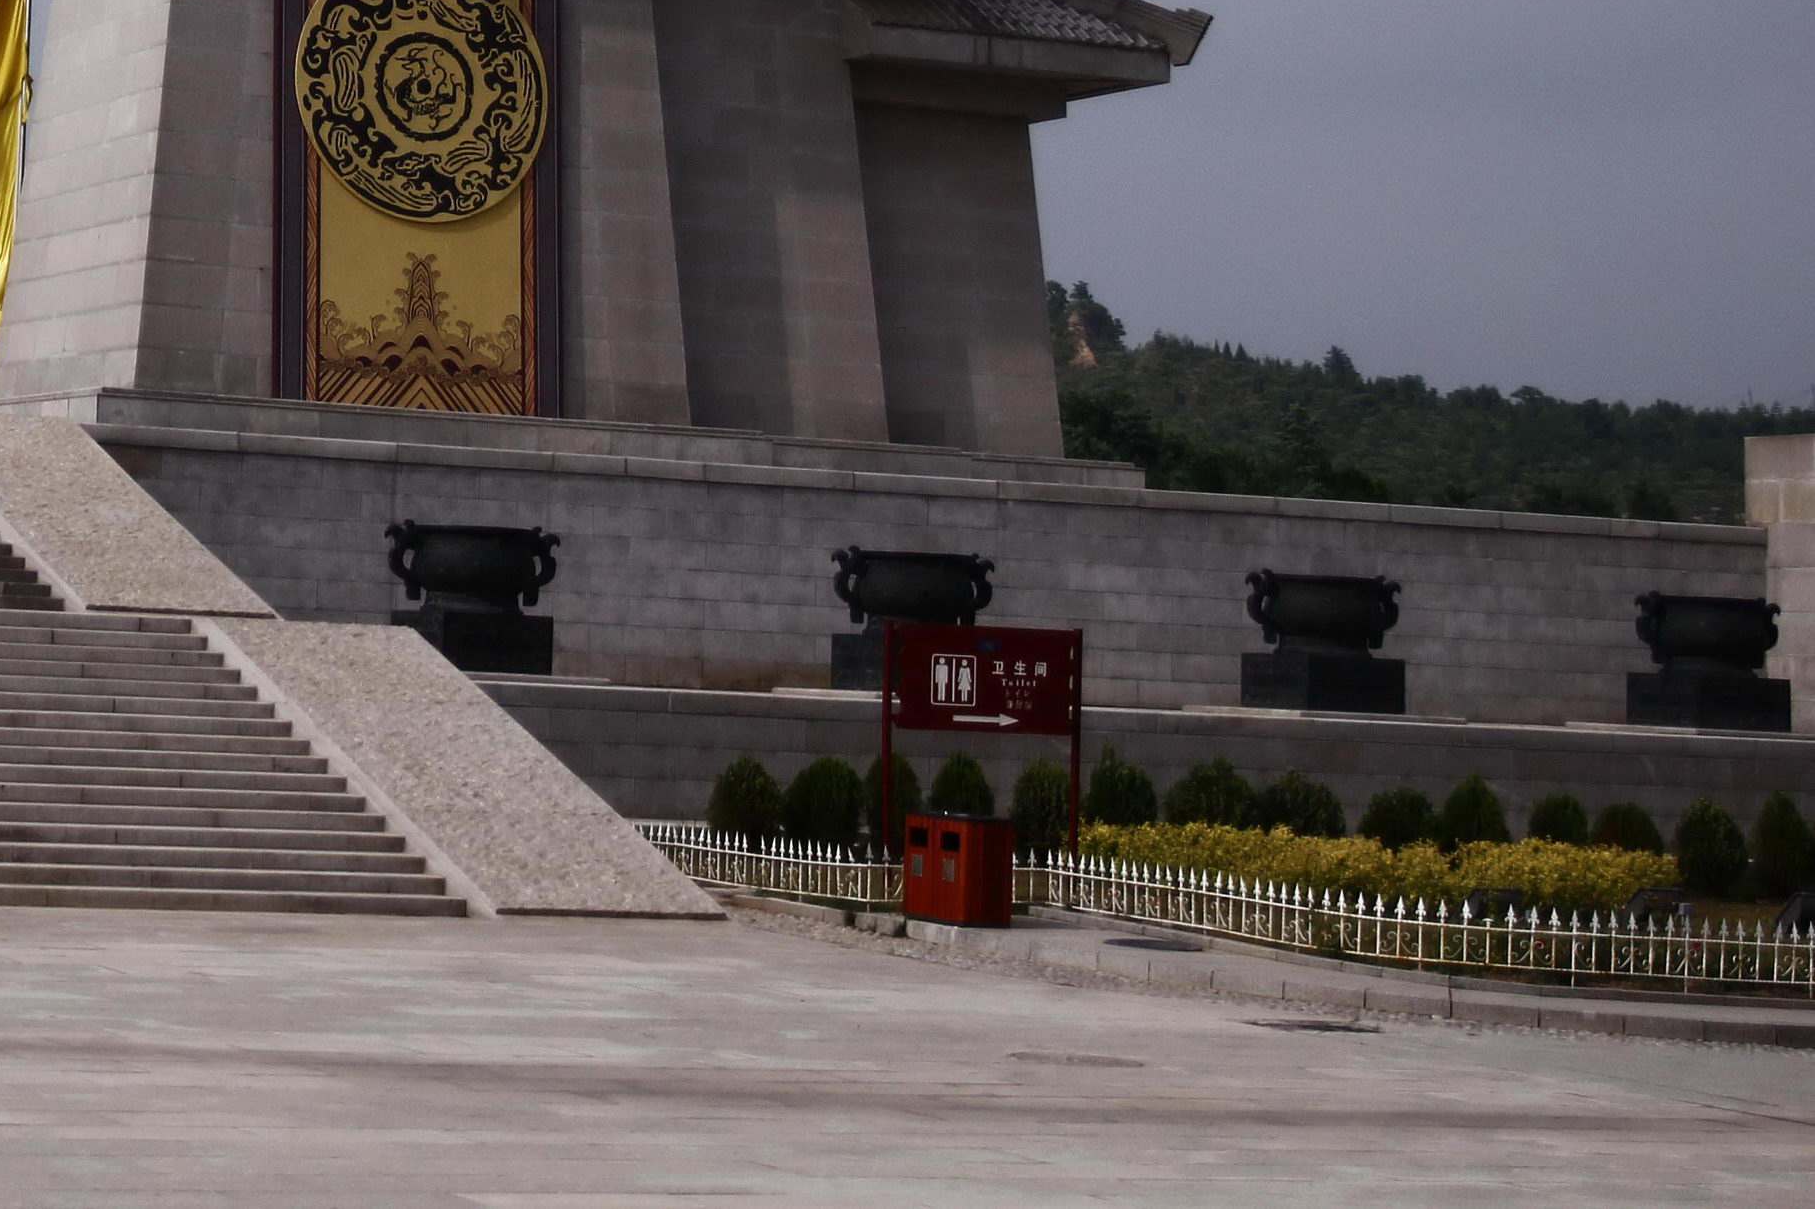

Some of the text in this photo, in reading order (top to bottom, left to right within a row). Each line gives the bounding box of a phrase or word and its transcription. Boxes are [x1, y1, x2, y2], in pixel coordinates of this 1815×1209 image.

[991, 660, 1047, 677] 卫生间
[1002, 678, 1036, 687] Toilet
